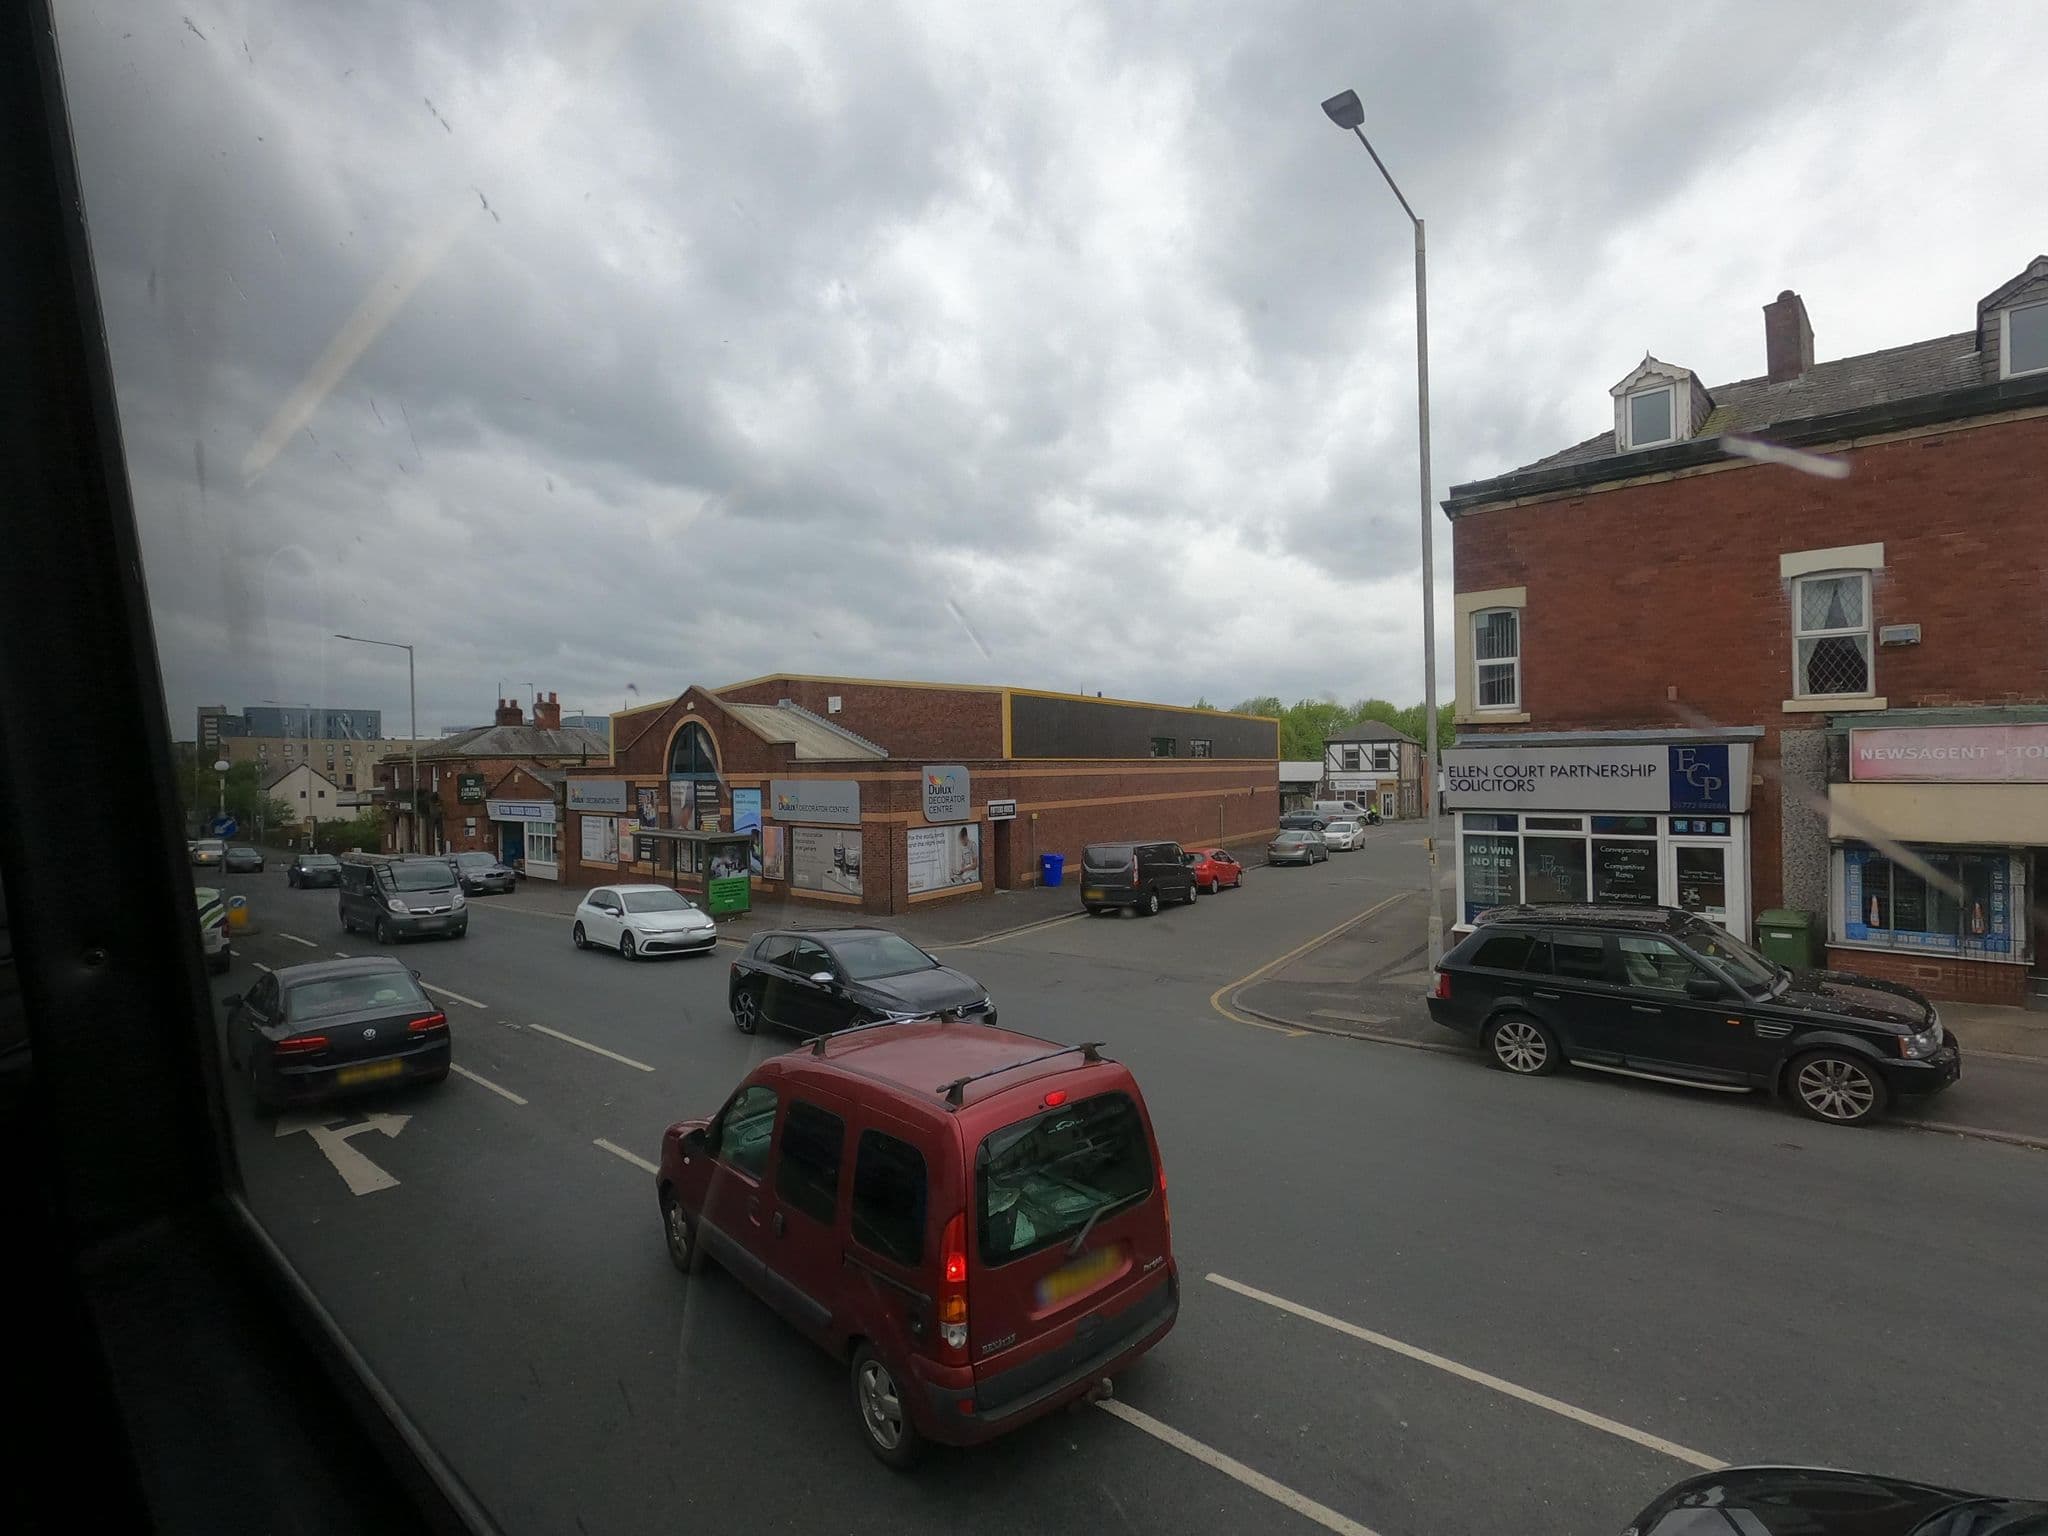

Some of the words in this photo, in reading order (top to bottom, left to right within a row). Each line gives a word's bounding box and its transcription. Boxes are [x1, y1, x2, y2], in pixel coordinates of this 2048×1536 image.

[1859, 746, 1989, 761] NEWSAGENT
[1448, 765, 1488, 778] ELLEN
[1493, 764, 1545, 778] COURT
[1550, 763, 1657, 778] PARTNERSHIP
[928, 783, 953, 795] Dulux
[1449, 779, 1536, 792] SOLICITORS
[928, 794, 966, 805] DECORATOR
[777, 801, 796, 811] Dulux
[928, 804, 953, 815] CENTRE
[1469, 844, 1487, 854] NO
[1490, 846, 1514, 856] WIN
[1599, 845, 1650, 856] Conveyancing
[1472, 857, 1490, 867] NO
[1493, 858, 1512, 868] FEE
